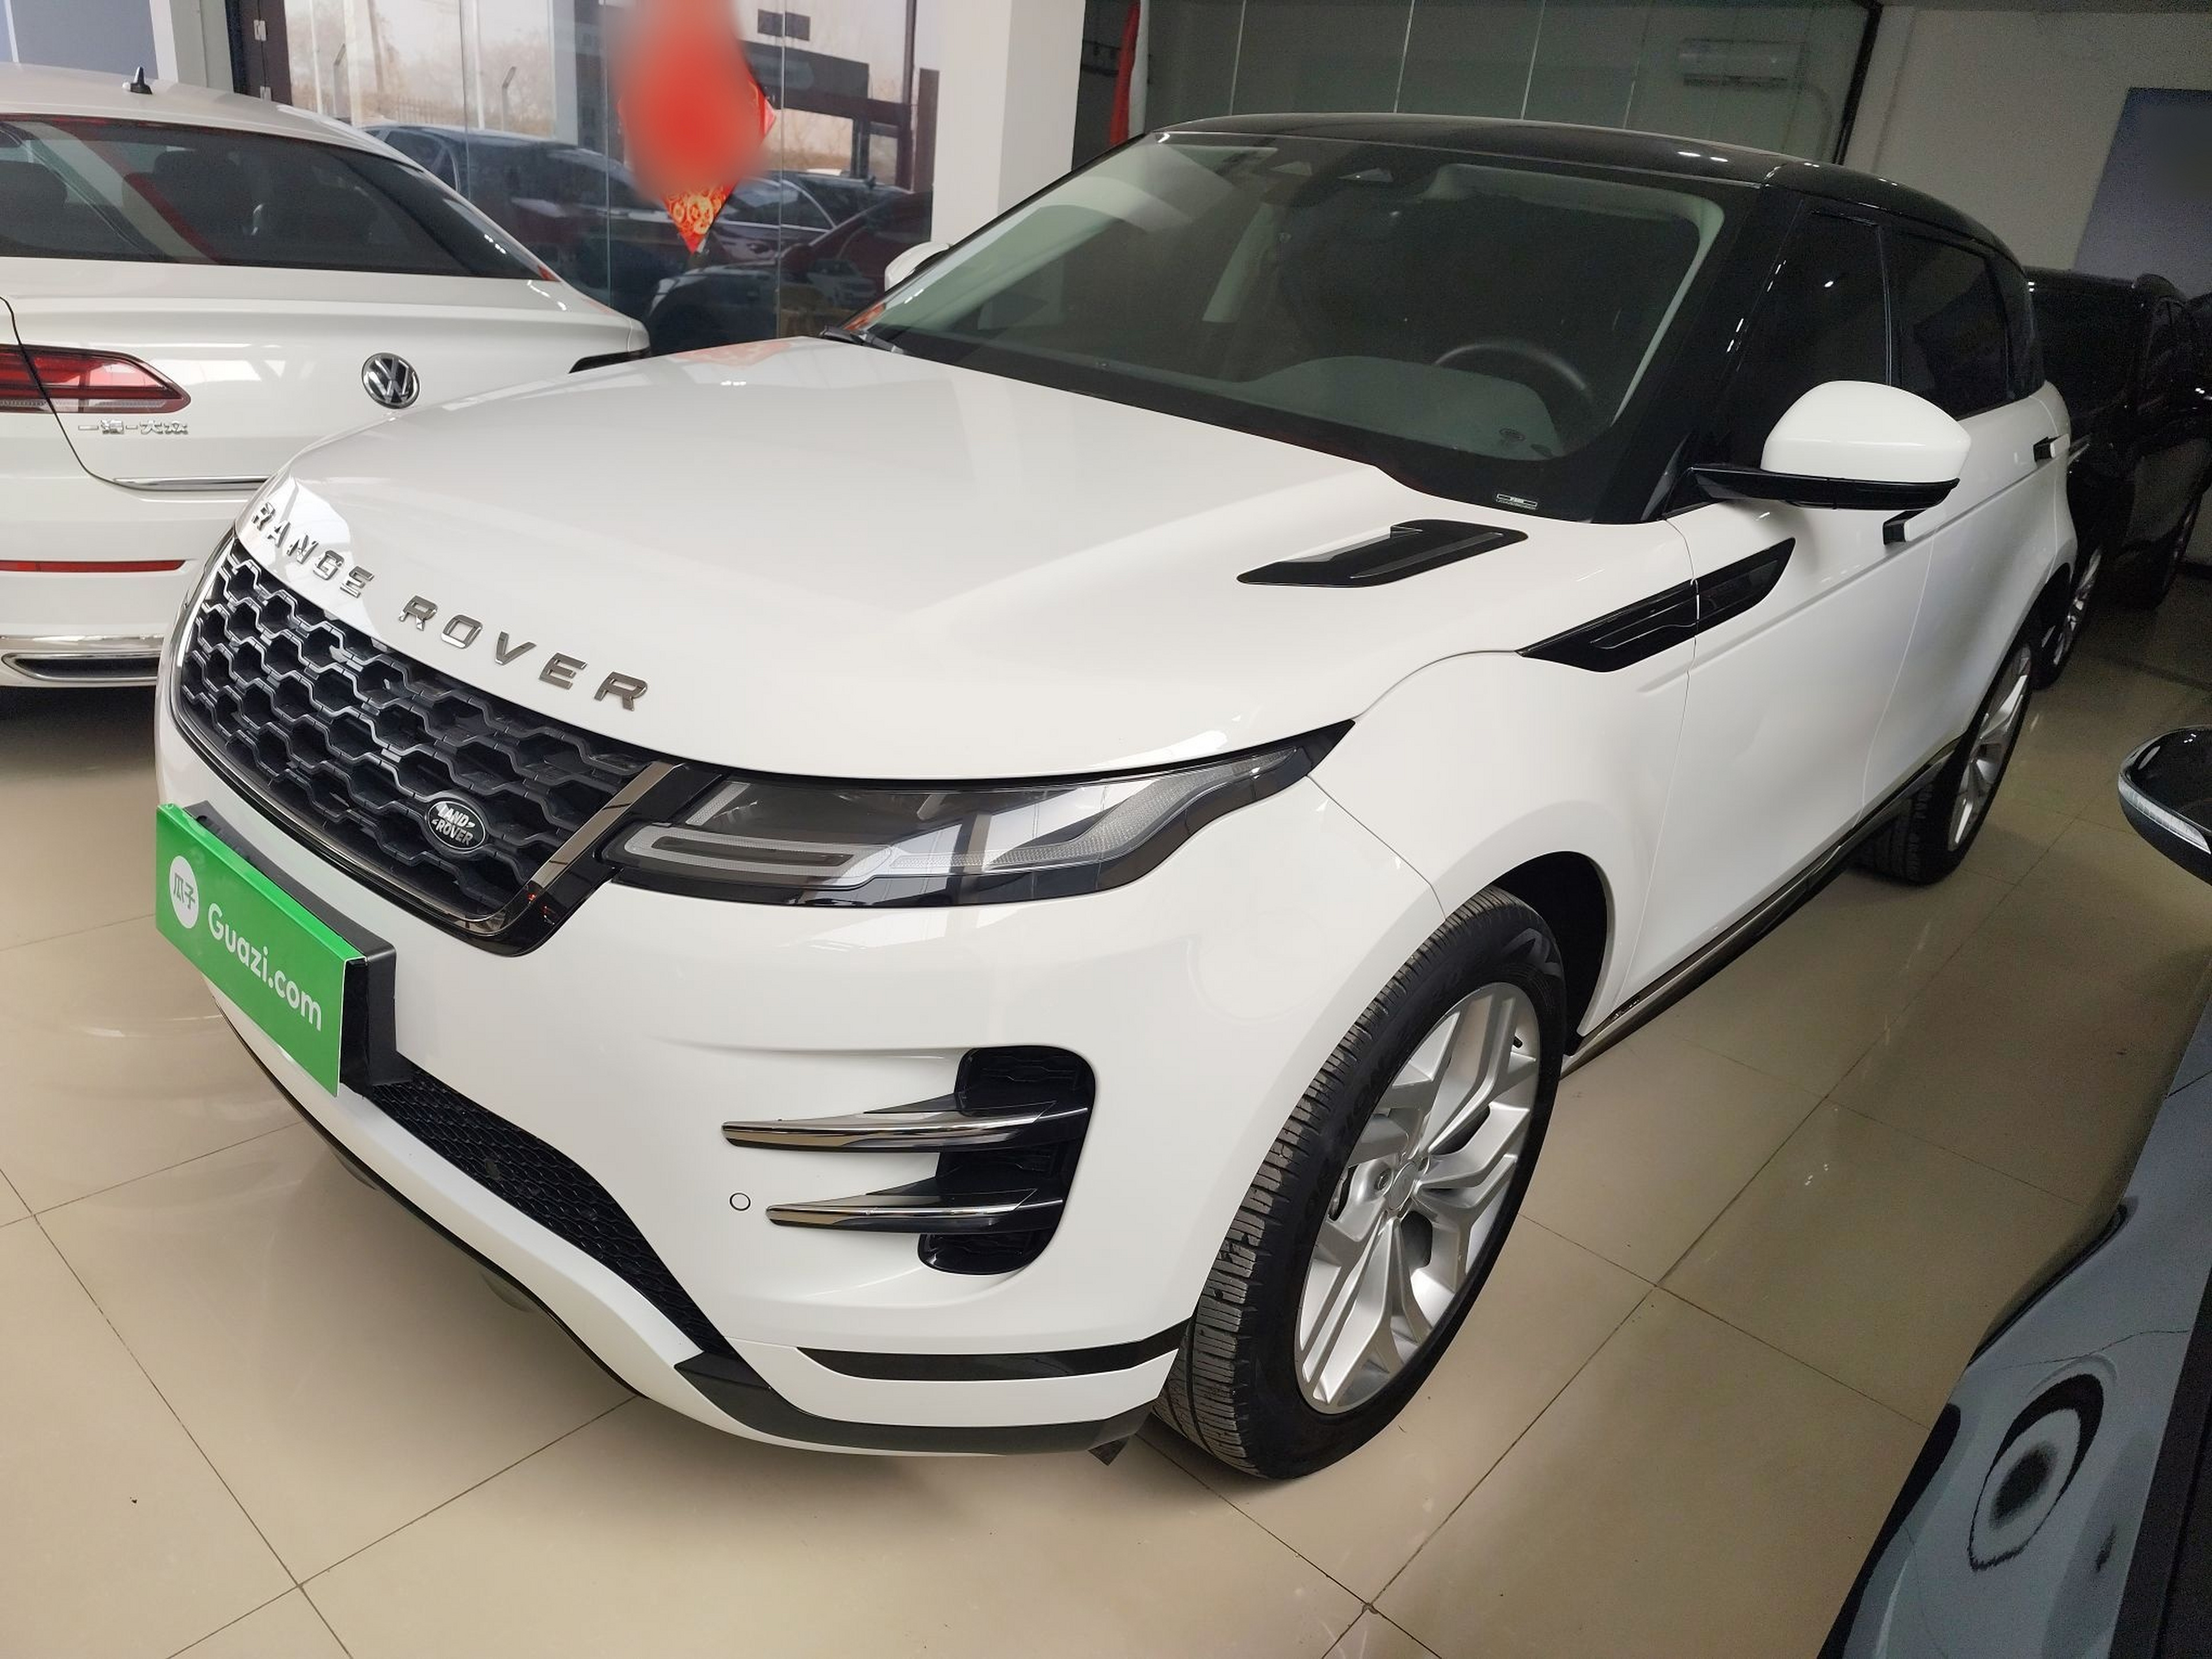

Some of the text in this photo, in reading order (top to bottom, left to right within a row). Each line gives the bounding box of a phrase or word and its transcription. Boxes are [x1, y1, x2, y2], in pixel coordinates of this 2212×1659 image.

[252, 502, 648, 712] RANGE ROVER
[435, 818, 474, 846] ROVER
[437, 803, 469, 828] LAND
[172, 872, 196, 910] 瓜子
[207, 902, 322, 1032] Guazi.com
